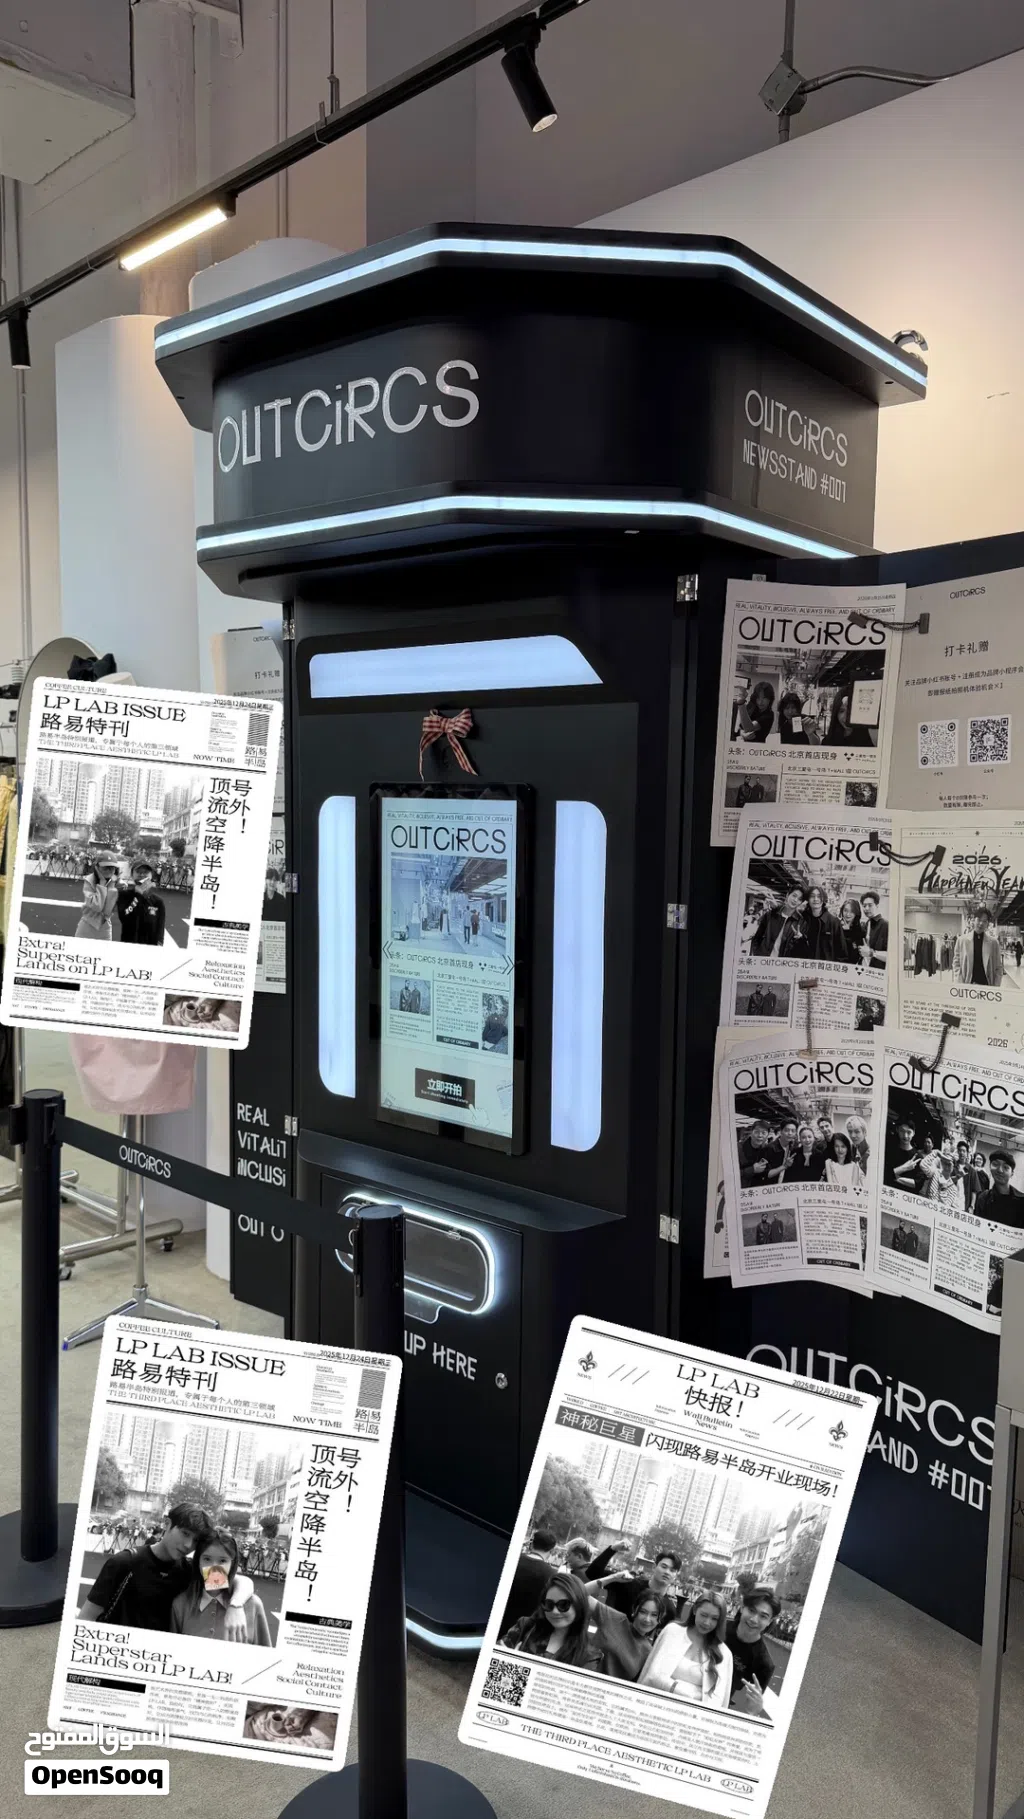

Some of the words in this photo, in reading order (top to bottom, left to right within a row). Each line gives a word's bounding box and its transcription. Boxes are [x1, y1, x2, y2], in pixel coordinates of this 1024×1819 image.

[218, 360, 479, 473] OUTCiRCS
[745, 389, 848, 468] OUTCiRCS
[743, 438, 817, 490] NEWSSTAND
[820, 473, 846, 503] #001
[739, 616, 886, 646] OUTCiRCS
[945, 640, 989, 657] 打卡礼赠
[391, 825, 507, 854] OUTCiRCS
[952, 855, 1002, 864] 2026
[988, 1037, 1008, 1048] 2026
[426, 1078, 462, 1097] 立即开拍
[734, 1061, 874, 1091] OUTCiRCS
[237, 1102, 270, 1127] REAL
[119, 1144, 172, 1179] OUTCiRCS
[404, 1330, 426, 1356] UP
[432, 1342, 478, 1381] HERE
